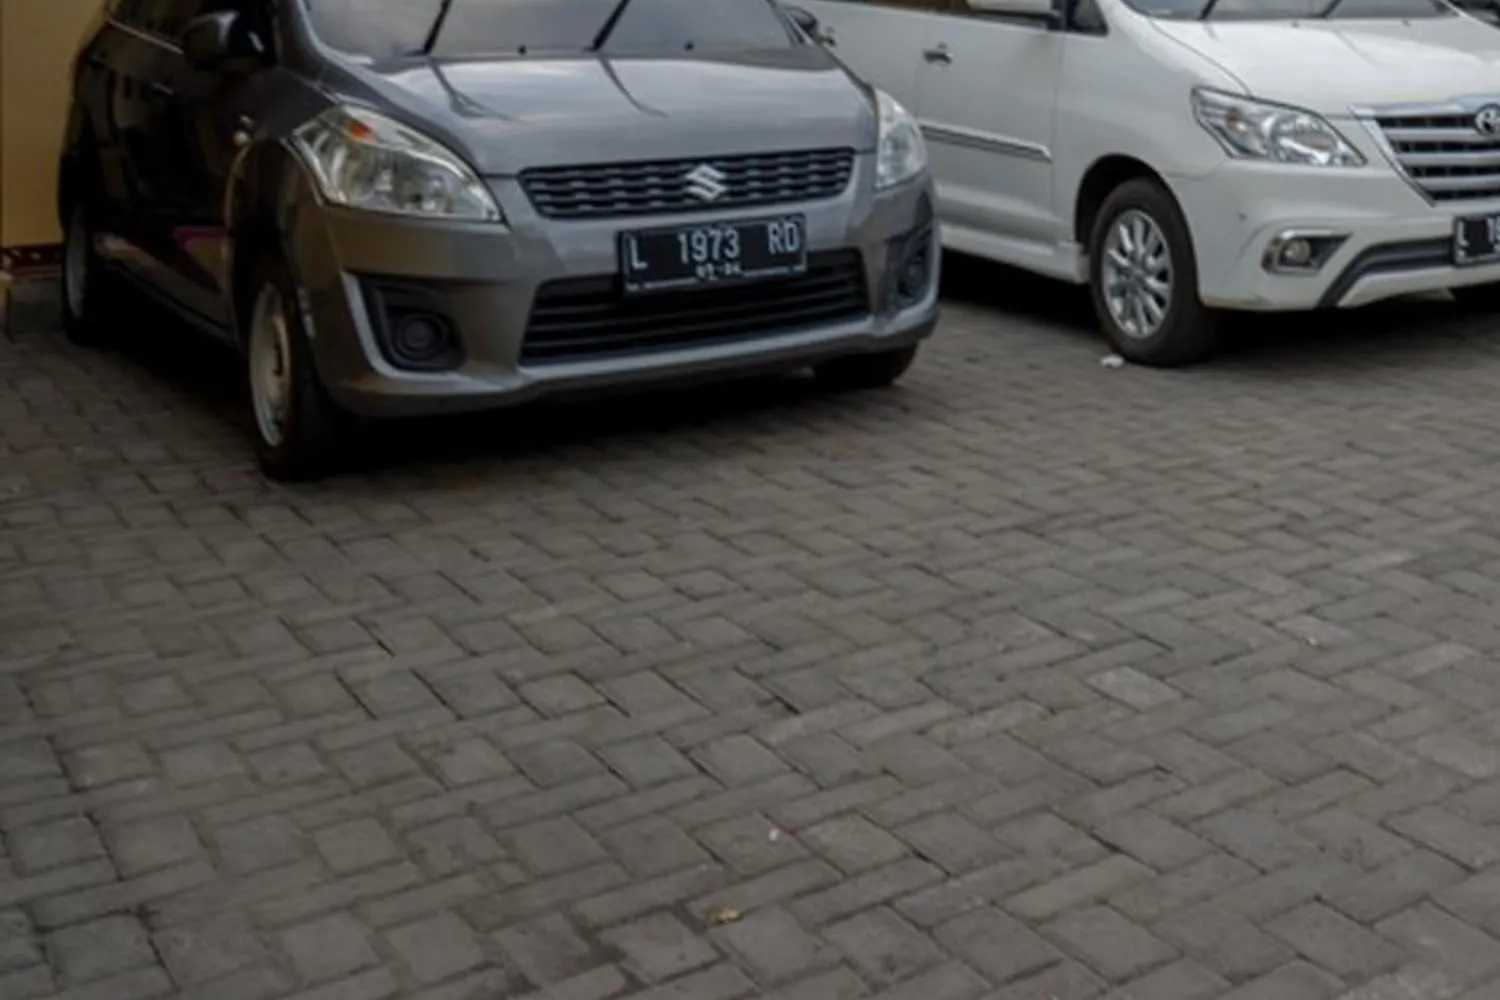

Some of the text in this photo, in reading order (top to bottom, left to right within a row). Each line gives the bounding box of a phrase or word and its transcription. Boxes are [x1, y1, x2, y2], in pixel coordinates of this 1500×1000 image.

[629, 222, 799, 269] L 1973 RD
[1457, 221, 1470, 247] L
